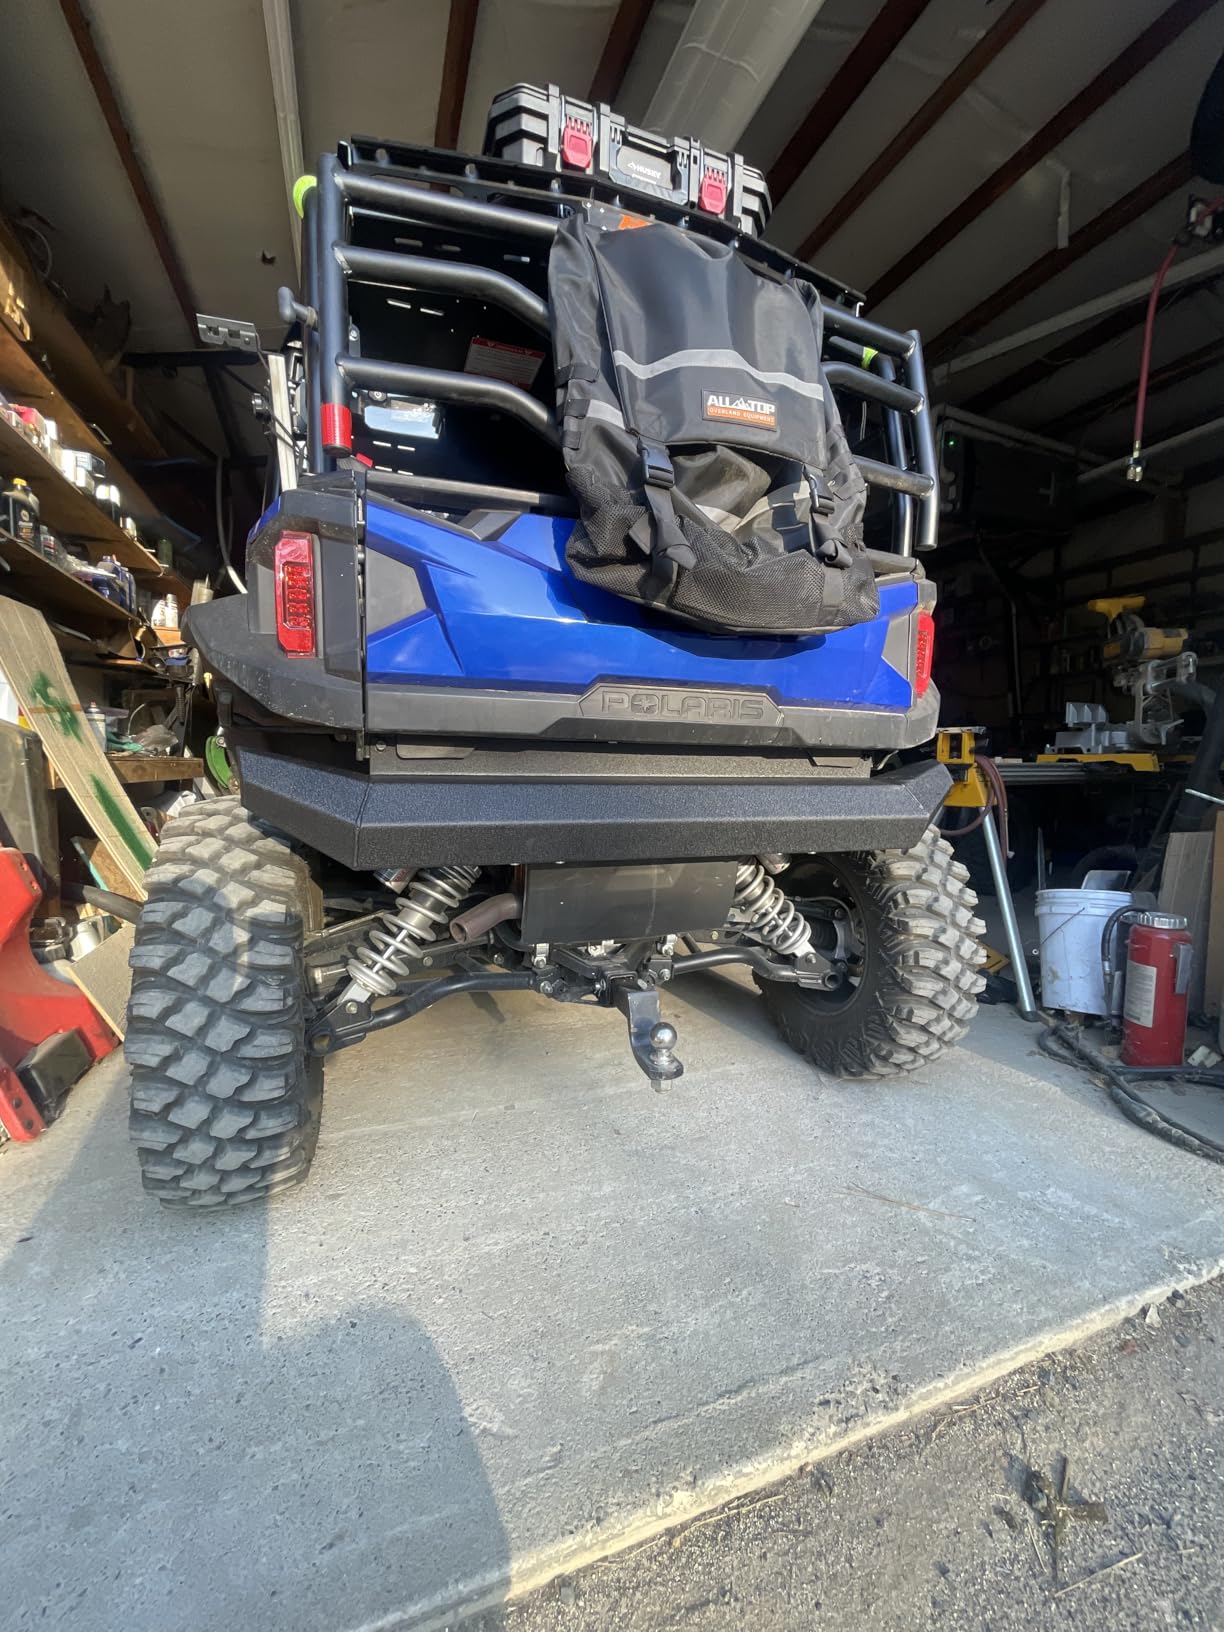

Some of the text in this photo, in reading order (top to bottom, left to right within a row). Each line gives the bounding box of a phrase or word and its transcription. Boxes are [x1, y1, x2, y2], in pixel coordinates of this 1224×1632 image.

[637, 164, 662, 179] HUSKY
[709, 407, 776, 424] OVERLAND EQUIPMENT
[601, 690, 764, 721] POLARIS
